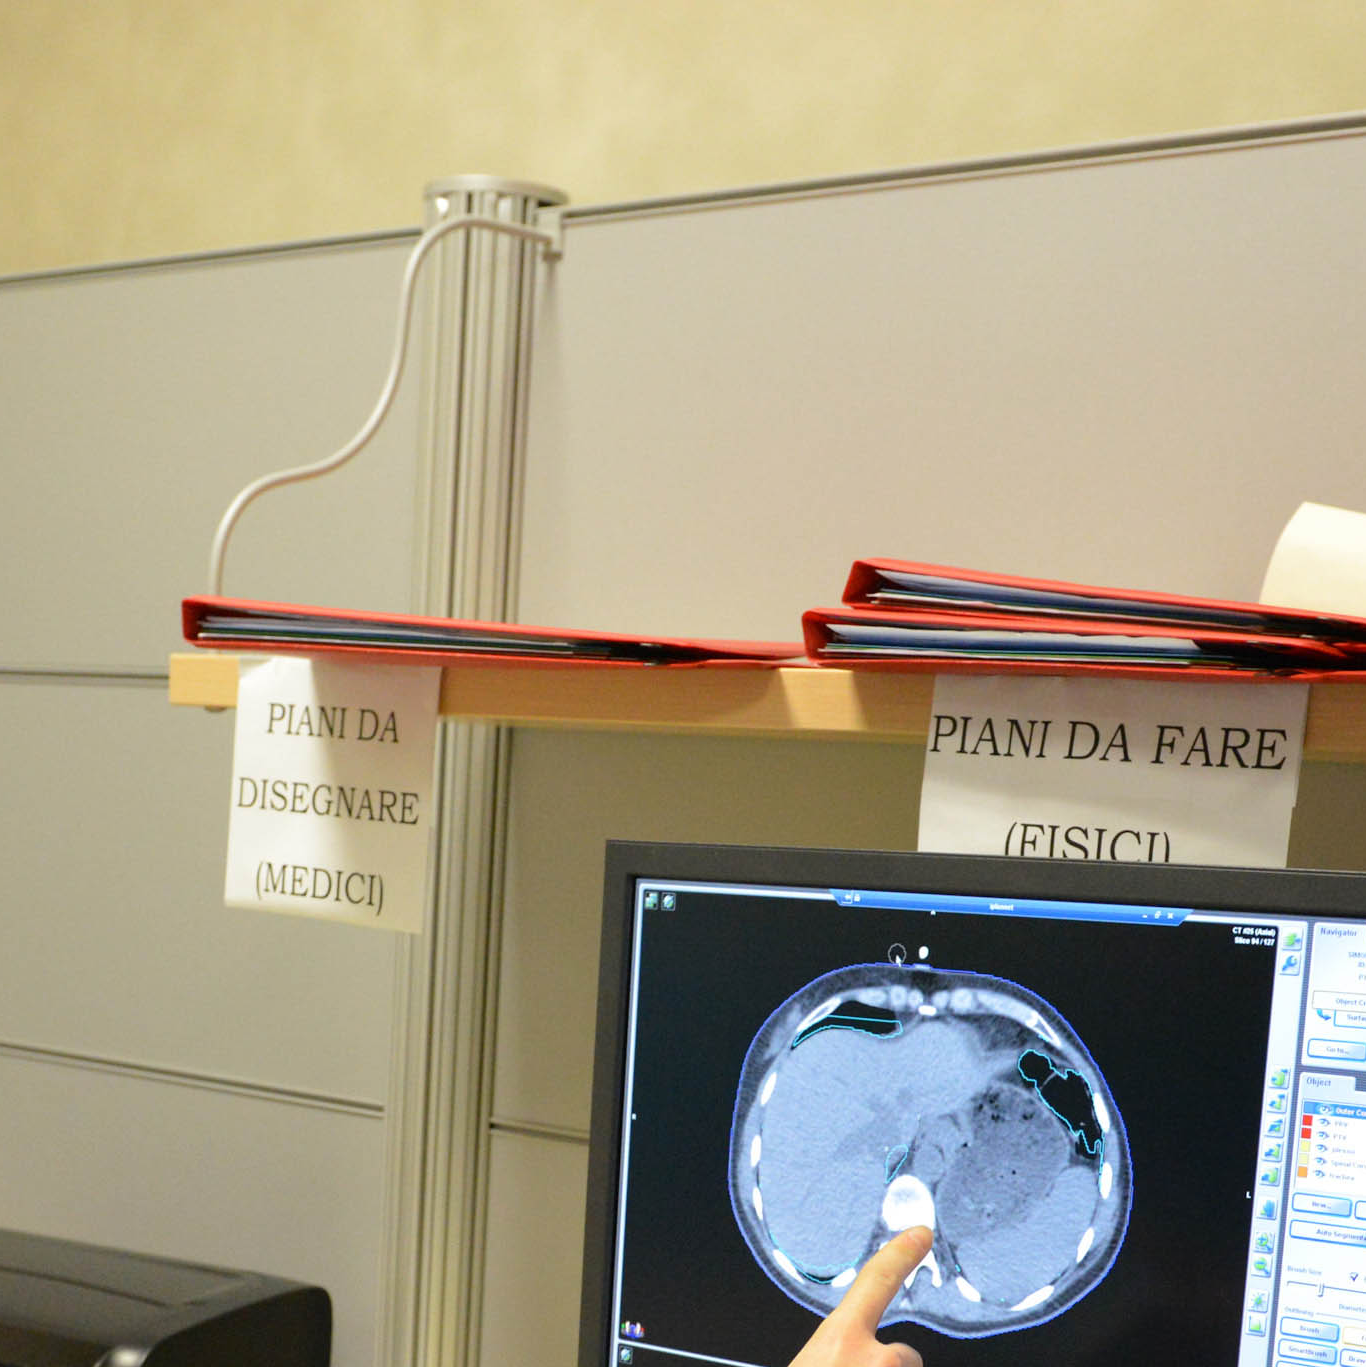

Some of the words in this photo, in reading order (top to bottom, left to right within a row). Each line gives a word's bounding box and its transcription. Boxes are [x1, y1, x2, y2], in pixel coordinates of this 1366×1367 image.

[266, 702, 349, 740] PIANI
[358, 708, 400, 744] DA
[929, 714, 1053, 759] PIANI
[1063, 720, 1133, 764] DA
[1151, 725, 1287, 771] FARE
[237, 777, 420, 826] DISEGNARE
[254, 860, 385, 916] (MEDICI)
[1232, 926, 1242, 934] CT
[1320, 927, 1358, 938] Navigator
[1234, 936, 1250, 945] Slice
[1263, 938, 1276, 947] 127
[1306, 1076, 1332, 1088] Object
[1335, 1106, 1355, 1116] Outer
